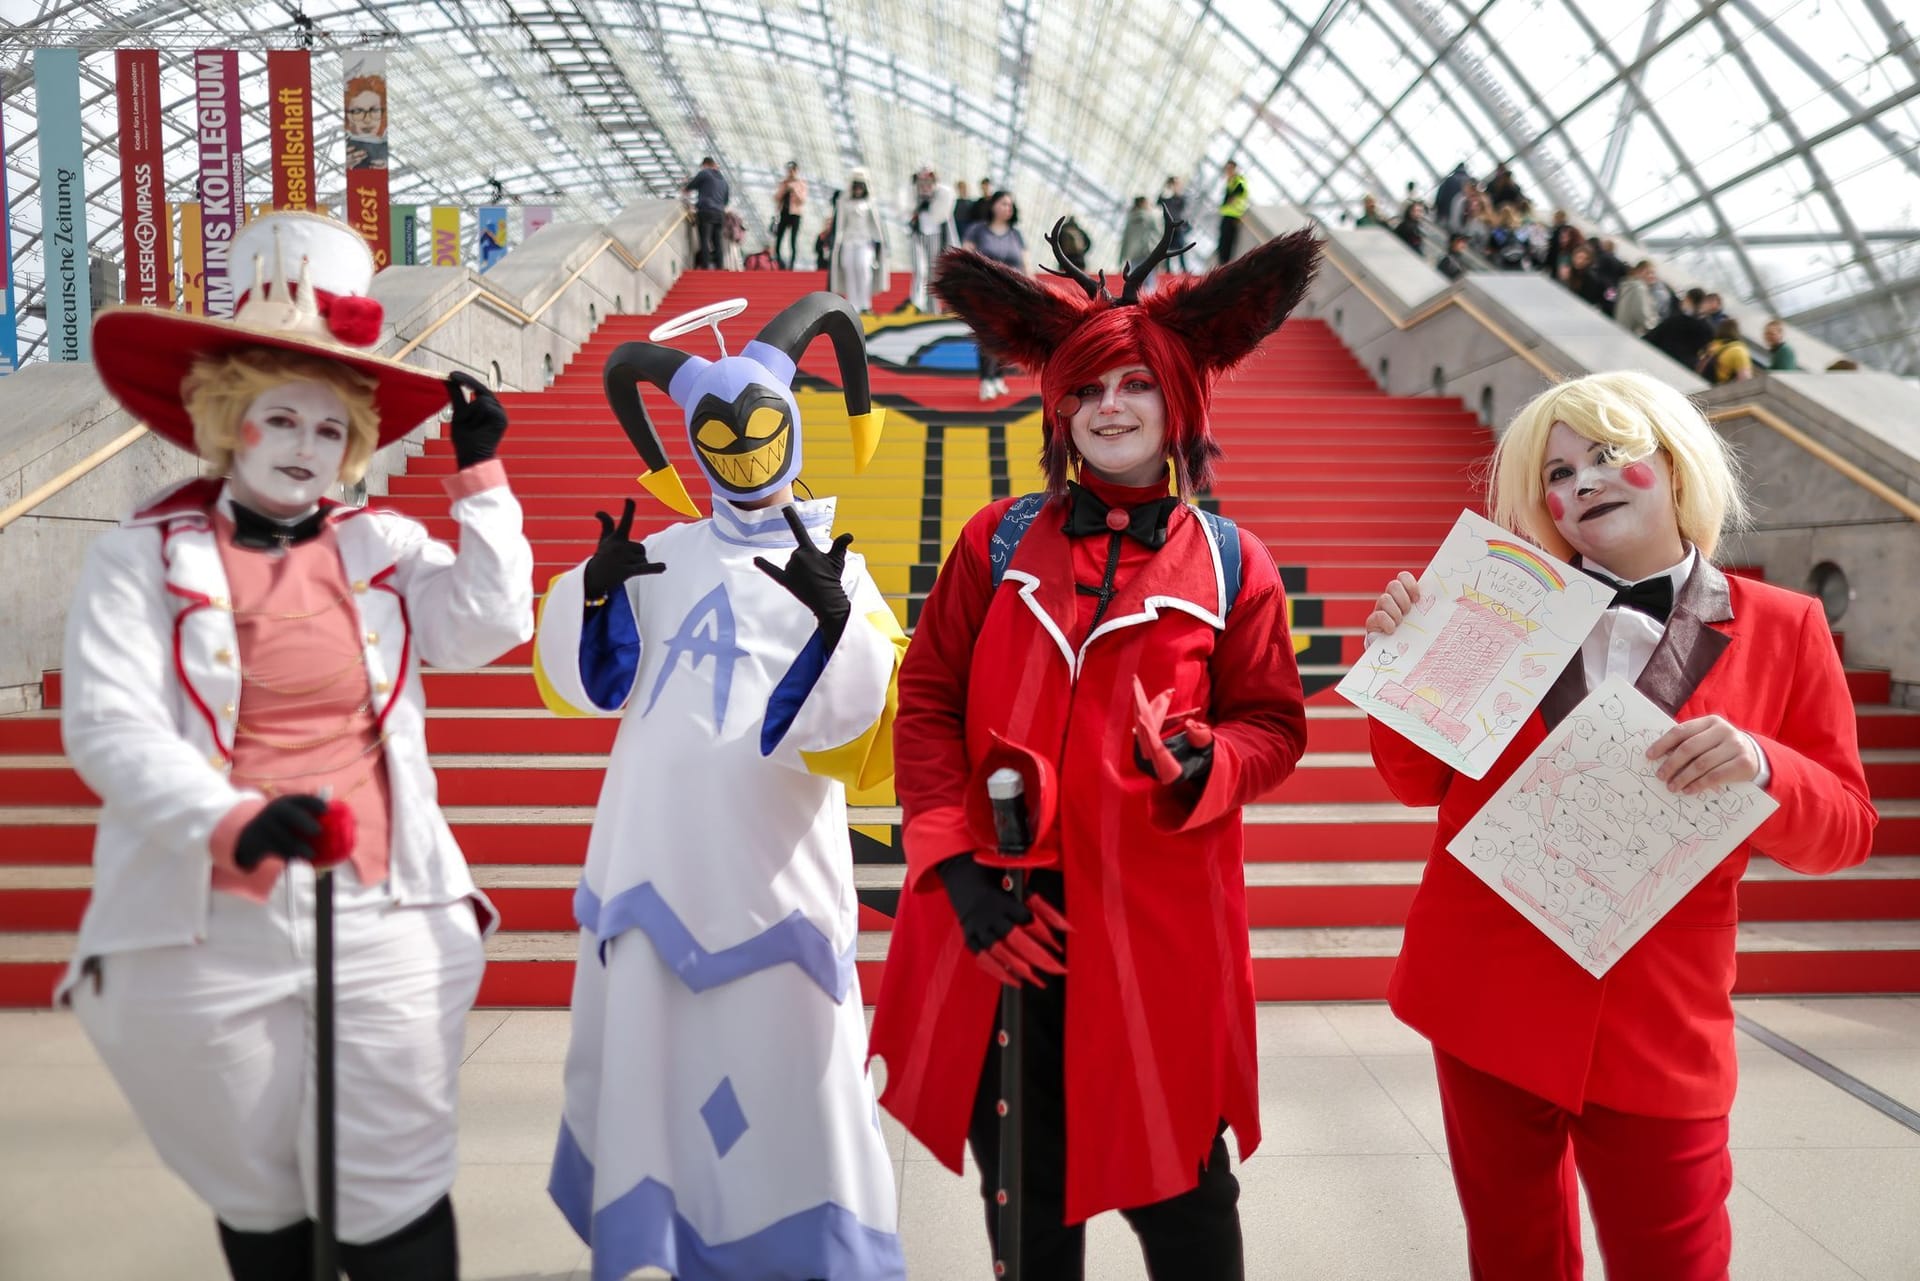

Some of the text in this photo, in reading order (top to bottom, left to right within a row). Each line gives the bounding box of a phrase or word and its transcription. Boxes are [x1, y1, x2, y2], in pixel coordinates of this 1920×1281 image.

[198, 55, 231, 215] KOLLEGIUM
[134, 163, 157, 291] LESEKOMPASS
[356, 186, 379, 241] liest
[54, 167, 79, 361] üddeutsche Zeitung
[207, 275, 234, 322] MM
[1487, 564, 1544, 597] HAZBIN
[1490, 580, 1526, 605] HOTEL
